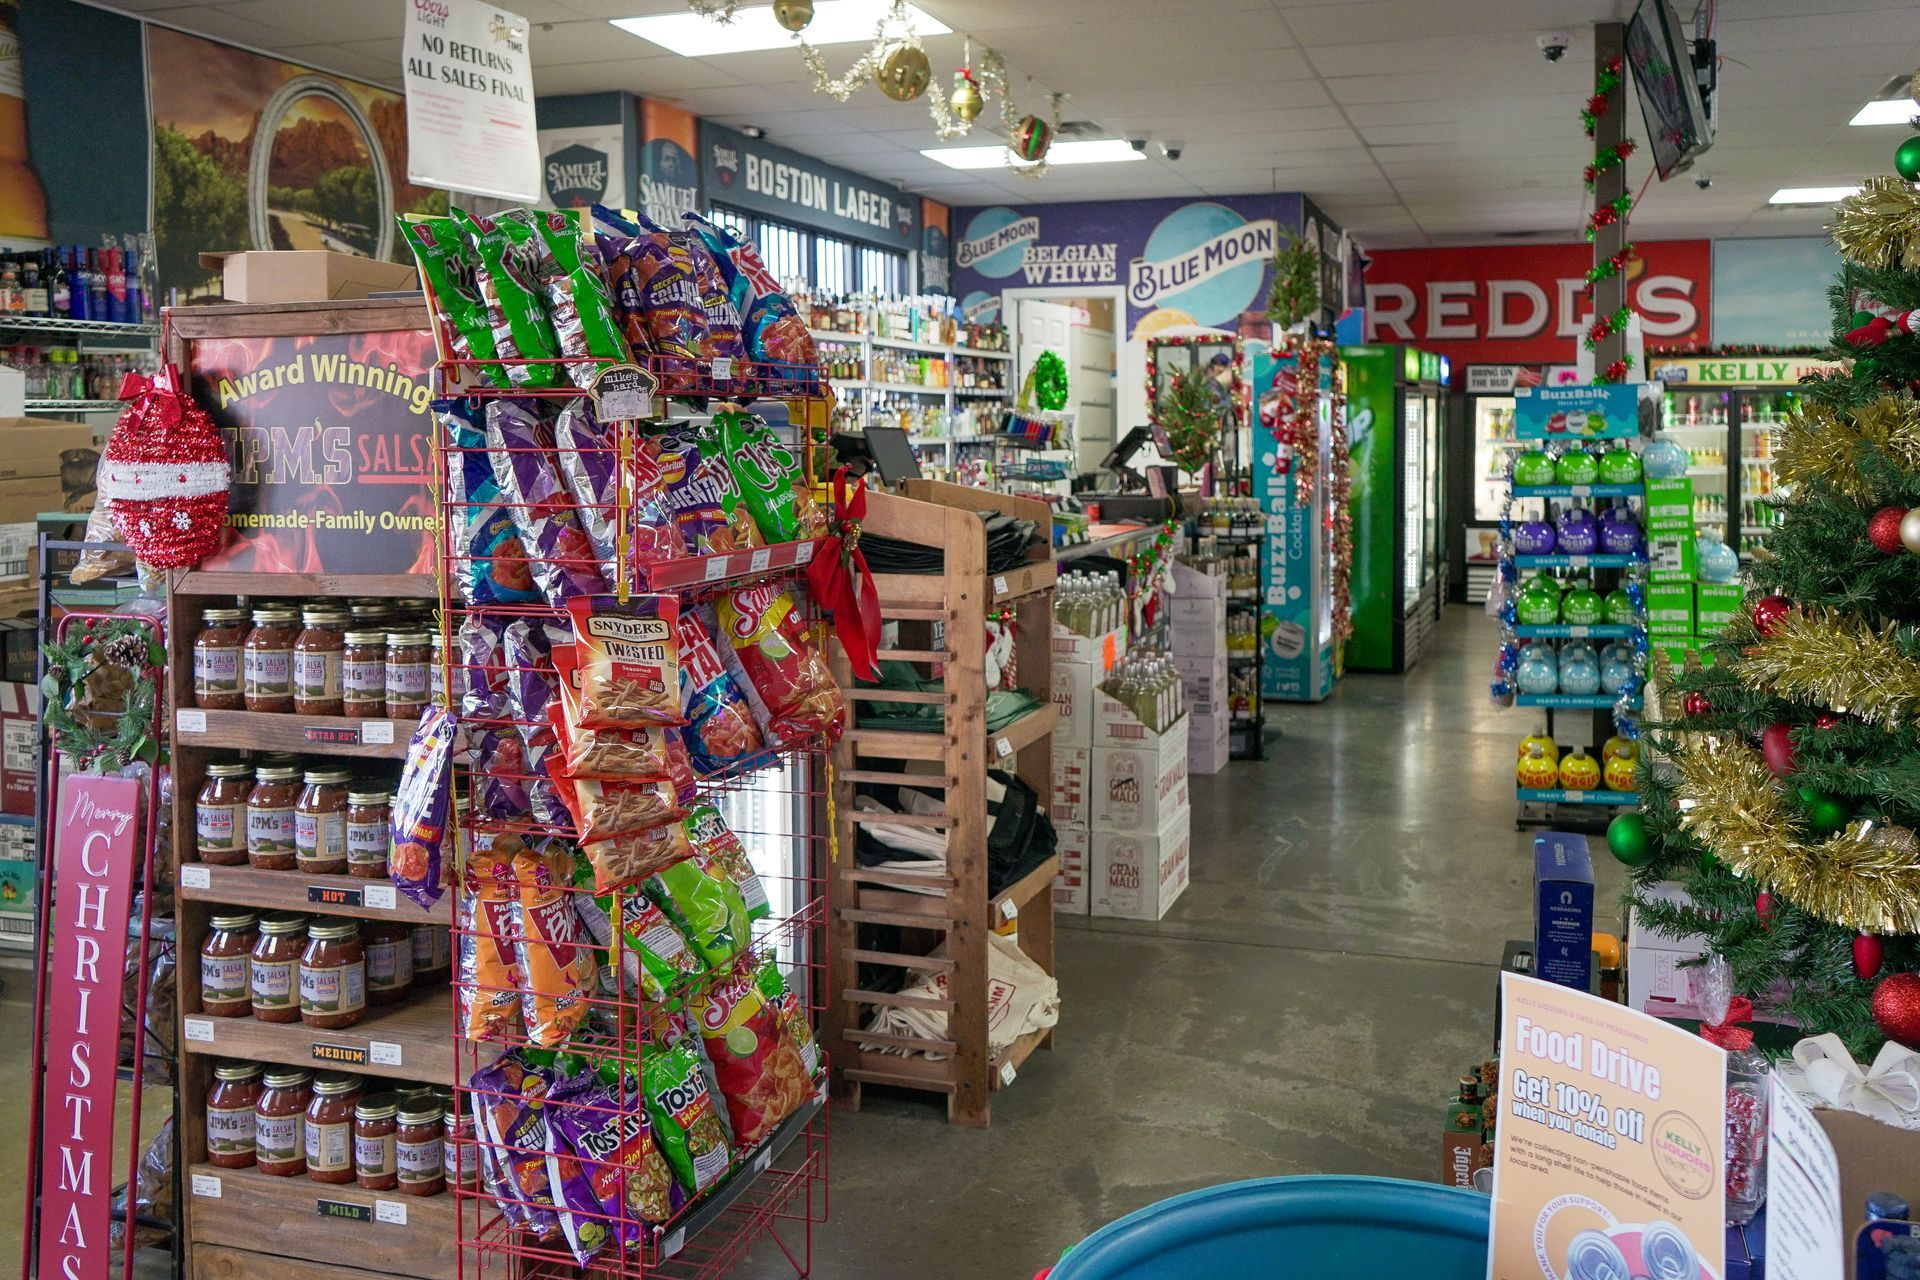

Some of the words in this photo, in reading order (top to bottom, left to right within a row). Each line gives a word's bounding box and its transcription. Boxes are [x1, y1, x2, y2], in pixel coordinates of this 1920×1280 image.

[417, 12, 446, 29] LIGHT
[422, 33, 444, 55] NO
[450, 41, 513, 75] RETURNS
[507, 39, 524, 54] TIME
[408, 57, 437, 81] ALL
[441, 64, 487, 93] SALES
[492, 78, 529, 104] FINAL
[548, 160, 607, 180] SAMUEL
[552, 175, 603, 195] ADAMS
[639, 173, 698, 209] SAMUEL
[745, 153, 828, 212] BOSTON
[833, 181, 891, 230] LAGER
[959, 239, 997, 262] BLUE
[999, 220, 1036, 248] MOON
[1022, 244, 1118, 264] BELGIAN
[1132, 254, 1200, 302] BLUE
[1203, 227, 1273, 273] MOON
[652, 272, 684, 291] RECETA
[1023, 262, 1117, 285] WHITE
[604, 371, 639, 384] mike's
[1698, 362, 1790, 382] KELLY
[217, 353, 305, 411] Award
[311, 353, 432, 416] Winning
[612, 380, 640, 390] hard
[1650, 482, 1686, 491] BIGGIES
[223, 509, 376, 535] omemade-Family
[1653, 520, 1689, 530] BIGGIES
[1266, 470, 1287, 606] BuzzBall
[1654, 534, 1689, 543] BIGGIES
[1655, 573, 1691, 581] BIGGIES
[1650, 587, 1686, 595] BIGGIES
[1703, 589, 1738, 598] BIGGIES
[593, 619, 664, 636] SNYDER'S
[1652, 625, 1688, 634] BIGGIES
[601, 640, 665, 661] TWISTED
[214, 654, 234, 667] SALSA
[265, 658, 287, 669] SALSA
[622, 664, 652, 675] Seasoned
[650, 680, 663, 689] BIG
[307, 731, 336, 742] EXTRA
[338, 731, 356, 743] HOT
[632, 731, 647, 740] BIG
[632, 736, 647, 744] FLAVOR
[1109, 778, 1140, 792] GRAN
[1109, 791, 1140, 804] MALO
[67, 788, 133, 838] Merry
[210, 814, 230, 823] SALSA
[651, 827, 666, 835] BIG
[1109, 864, 1140, 876] GRAN
[1109, 876, 1140, 889] MALO
[322, 890, 346, 903] HOT
[540, 899, 565, 918] PAPAS
[222, 964, 242, 974] SALSA
[267, 971, 286, 980] SALSA
[316, 976, 336, 986] SALSA
[315, 1046, 363, 1062] MEDIUM
[1515, 1015, 1584, 1072] Food
[1590, 1037, 1662, 1101] Drive
[655, 1063, 708, 1118] TOSTIT
[1512, 1067, 1551, 1108] Get
[1554, 1081, 1610, 1129] 10%
[681, 1104, 702, 1126] MÁS
[272, 1125, 292, 1135] SALSA
[1511, 1099, 1546, 1125] when
[1548, 1108, 1573, 1133] you
[1572, 1119, 1617, 1150] donate
[578, 1105, 652, 1162] TOSTITO
[363, 1144, 381, 1153] SALSA
[1664, 1130, 1702, 1156] KELLY
[1510, 1134, 1533, 1148] We're
[1533, 1140, 1572, 1163] collecting
[1572, 1155, 1631, 1185] non-perishable
[1655, 1136, 1713, 1174] LIQUORS
[1510, 1156, 1529, 1170] local
[1529, 1163, 1551, 1176] area.
[1510, 1145, 1526, 1157] with
[1534, 1152, 1552, 1167] long
[1553, 1159, 1572, 1173] shelf
[1573, 1164, 1585, 1177] life
[1595, 1173, 1613, 1189] help
[601, 1168, 621, 1188] Xtra
[329, 1203, 360, 1219] MILD
[1547, 1196, 1568, 1214] YOUR
[1537, 1211, 1550, 1232] FOR
[1536, 1231, 1544, 1251] YOU
